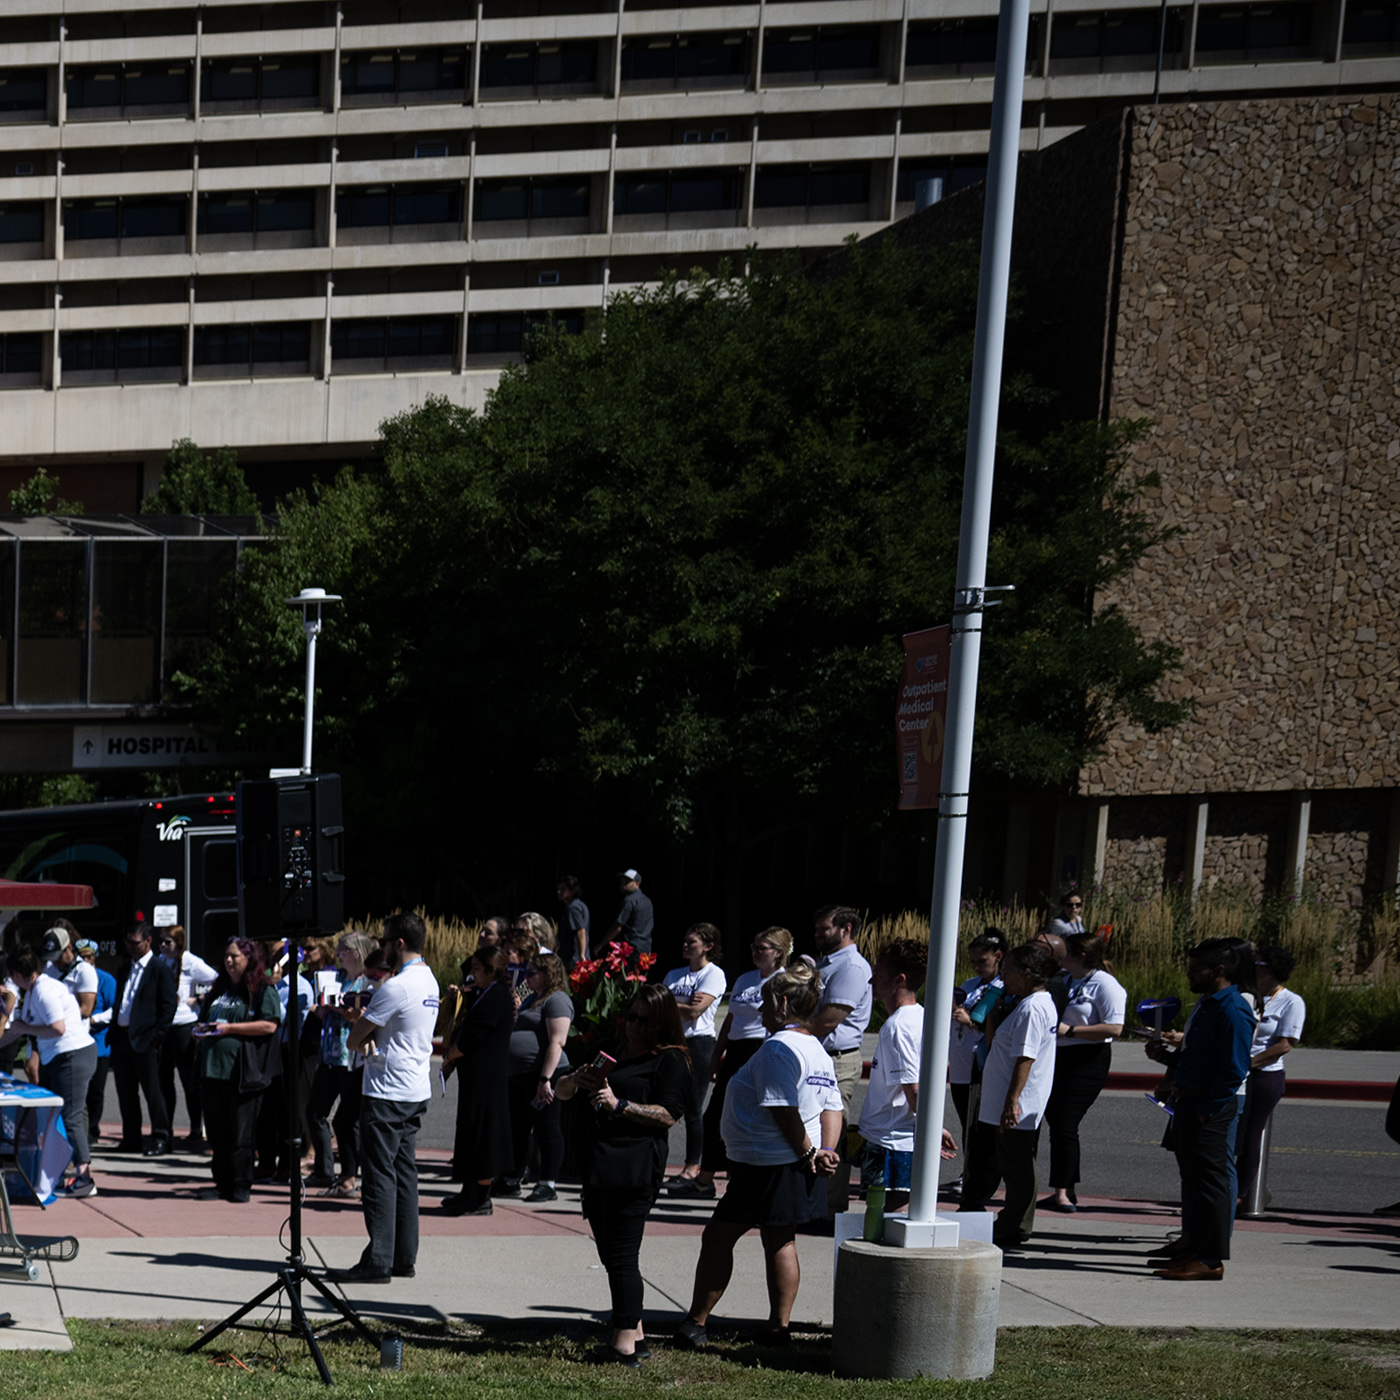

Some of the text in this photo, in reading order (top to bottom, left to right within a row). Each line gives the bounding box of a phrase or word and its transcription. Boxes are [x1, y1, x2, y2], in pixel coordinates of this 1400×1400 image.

[902, 679, 947, 698] Outpatient
[898, 697, 934, 716] Medical
[899, 717, 929, 732] Center
[109, 737, 209, 755] HOSPITAL
[155, 820, 185, 843] Via
